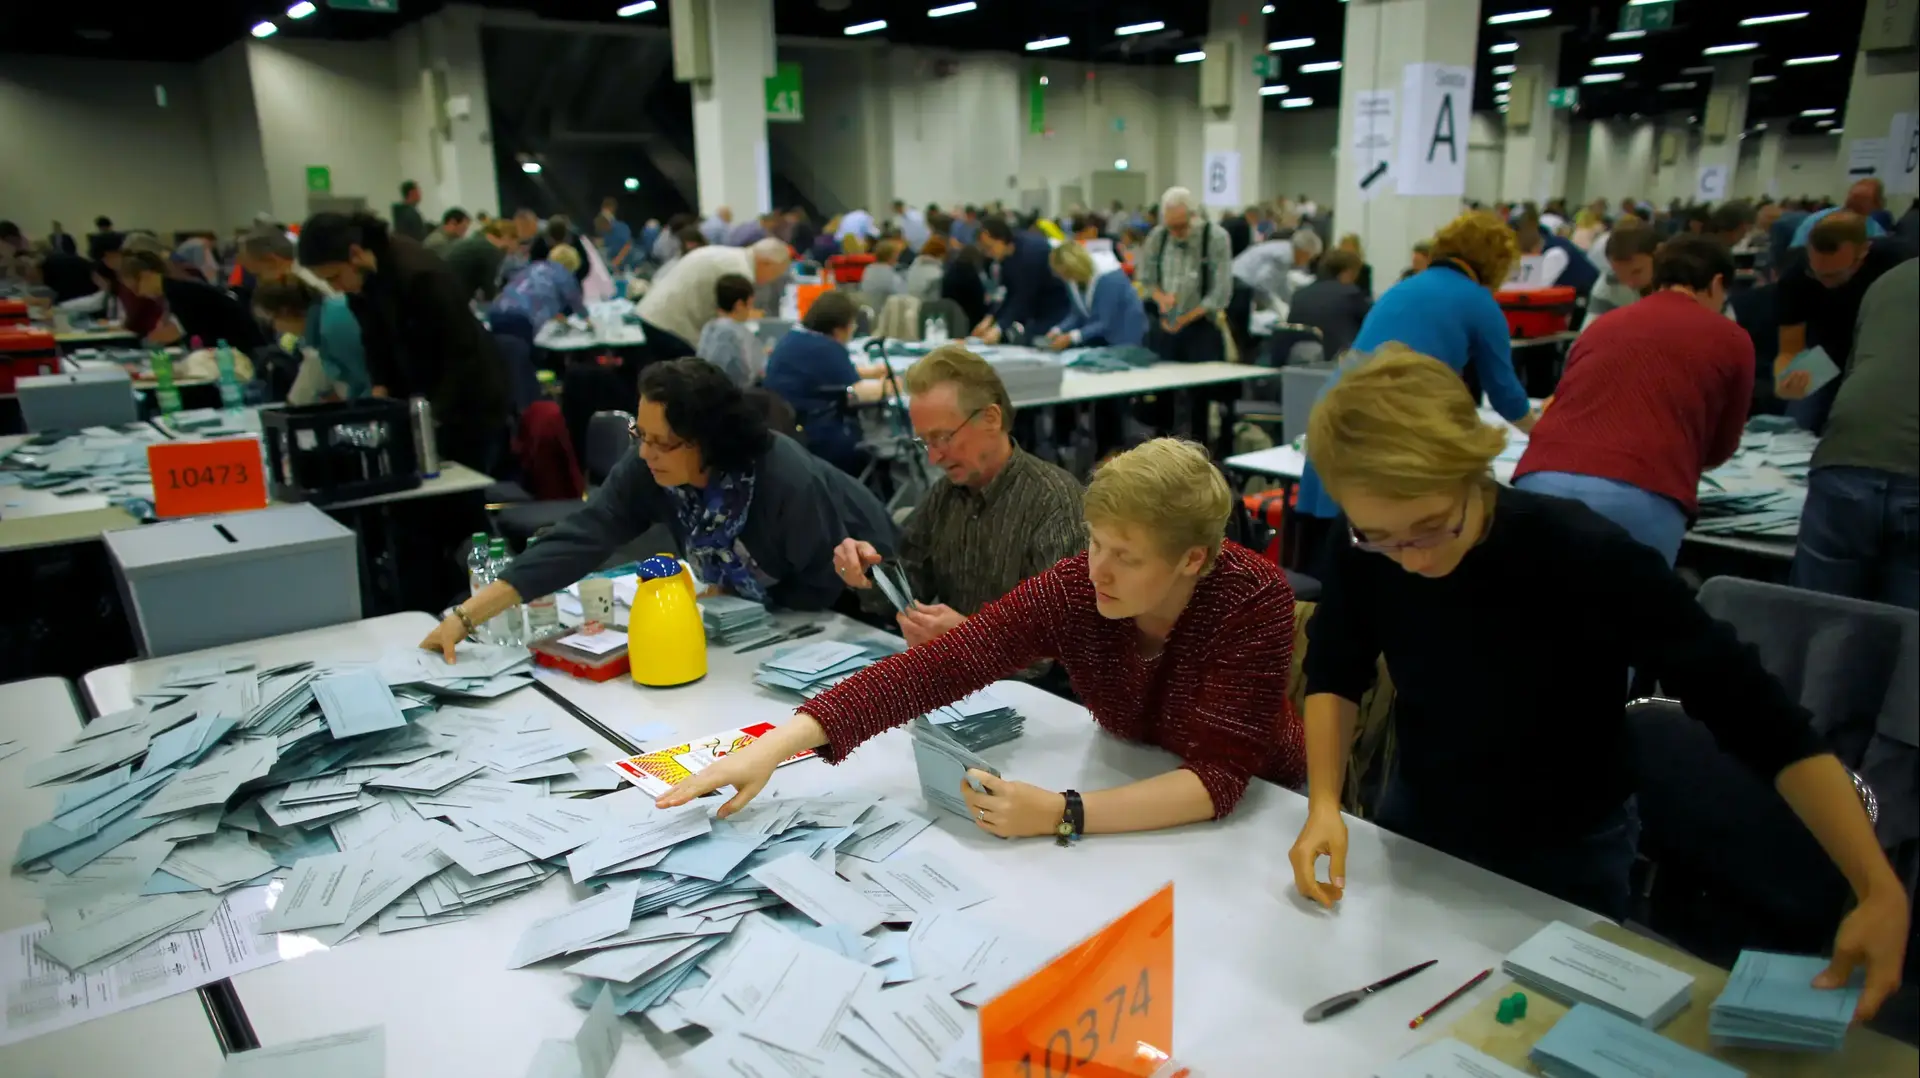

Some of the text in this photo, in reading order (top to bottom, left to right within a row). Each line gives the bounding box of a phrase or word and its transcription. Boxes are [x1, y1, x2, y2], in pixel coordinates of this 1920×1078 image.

[1426, 92, 1457, 164] A
[1210, 160, 1228, 194] B
[1700, 168, 1719, 194] C
[167, 463, 249, 490] 10473
